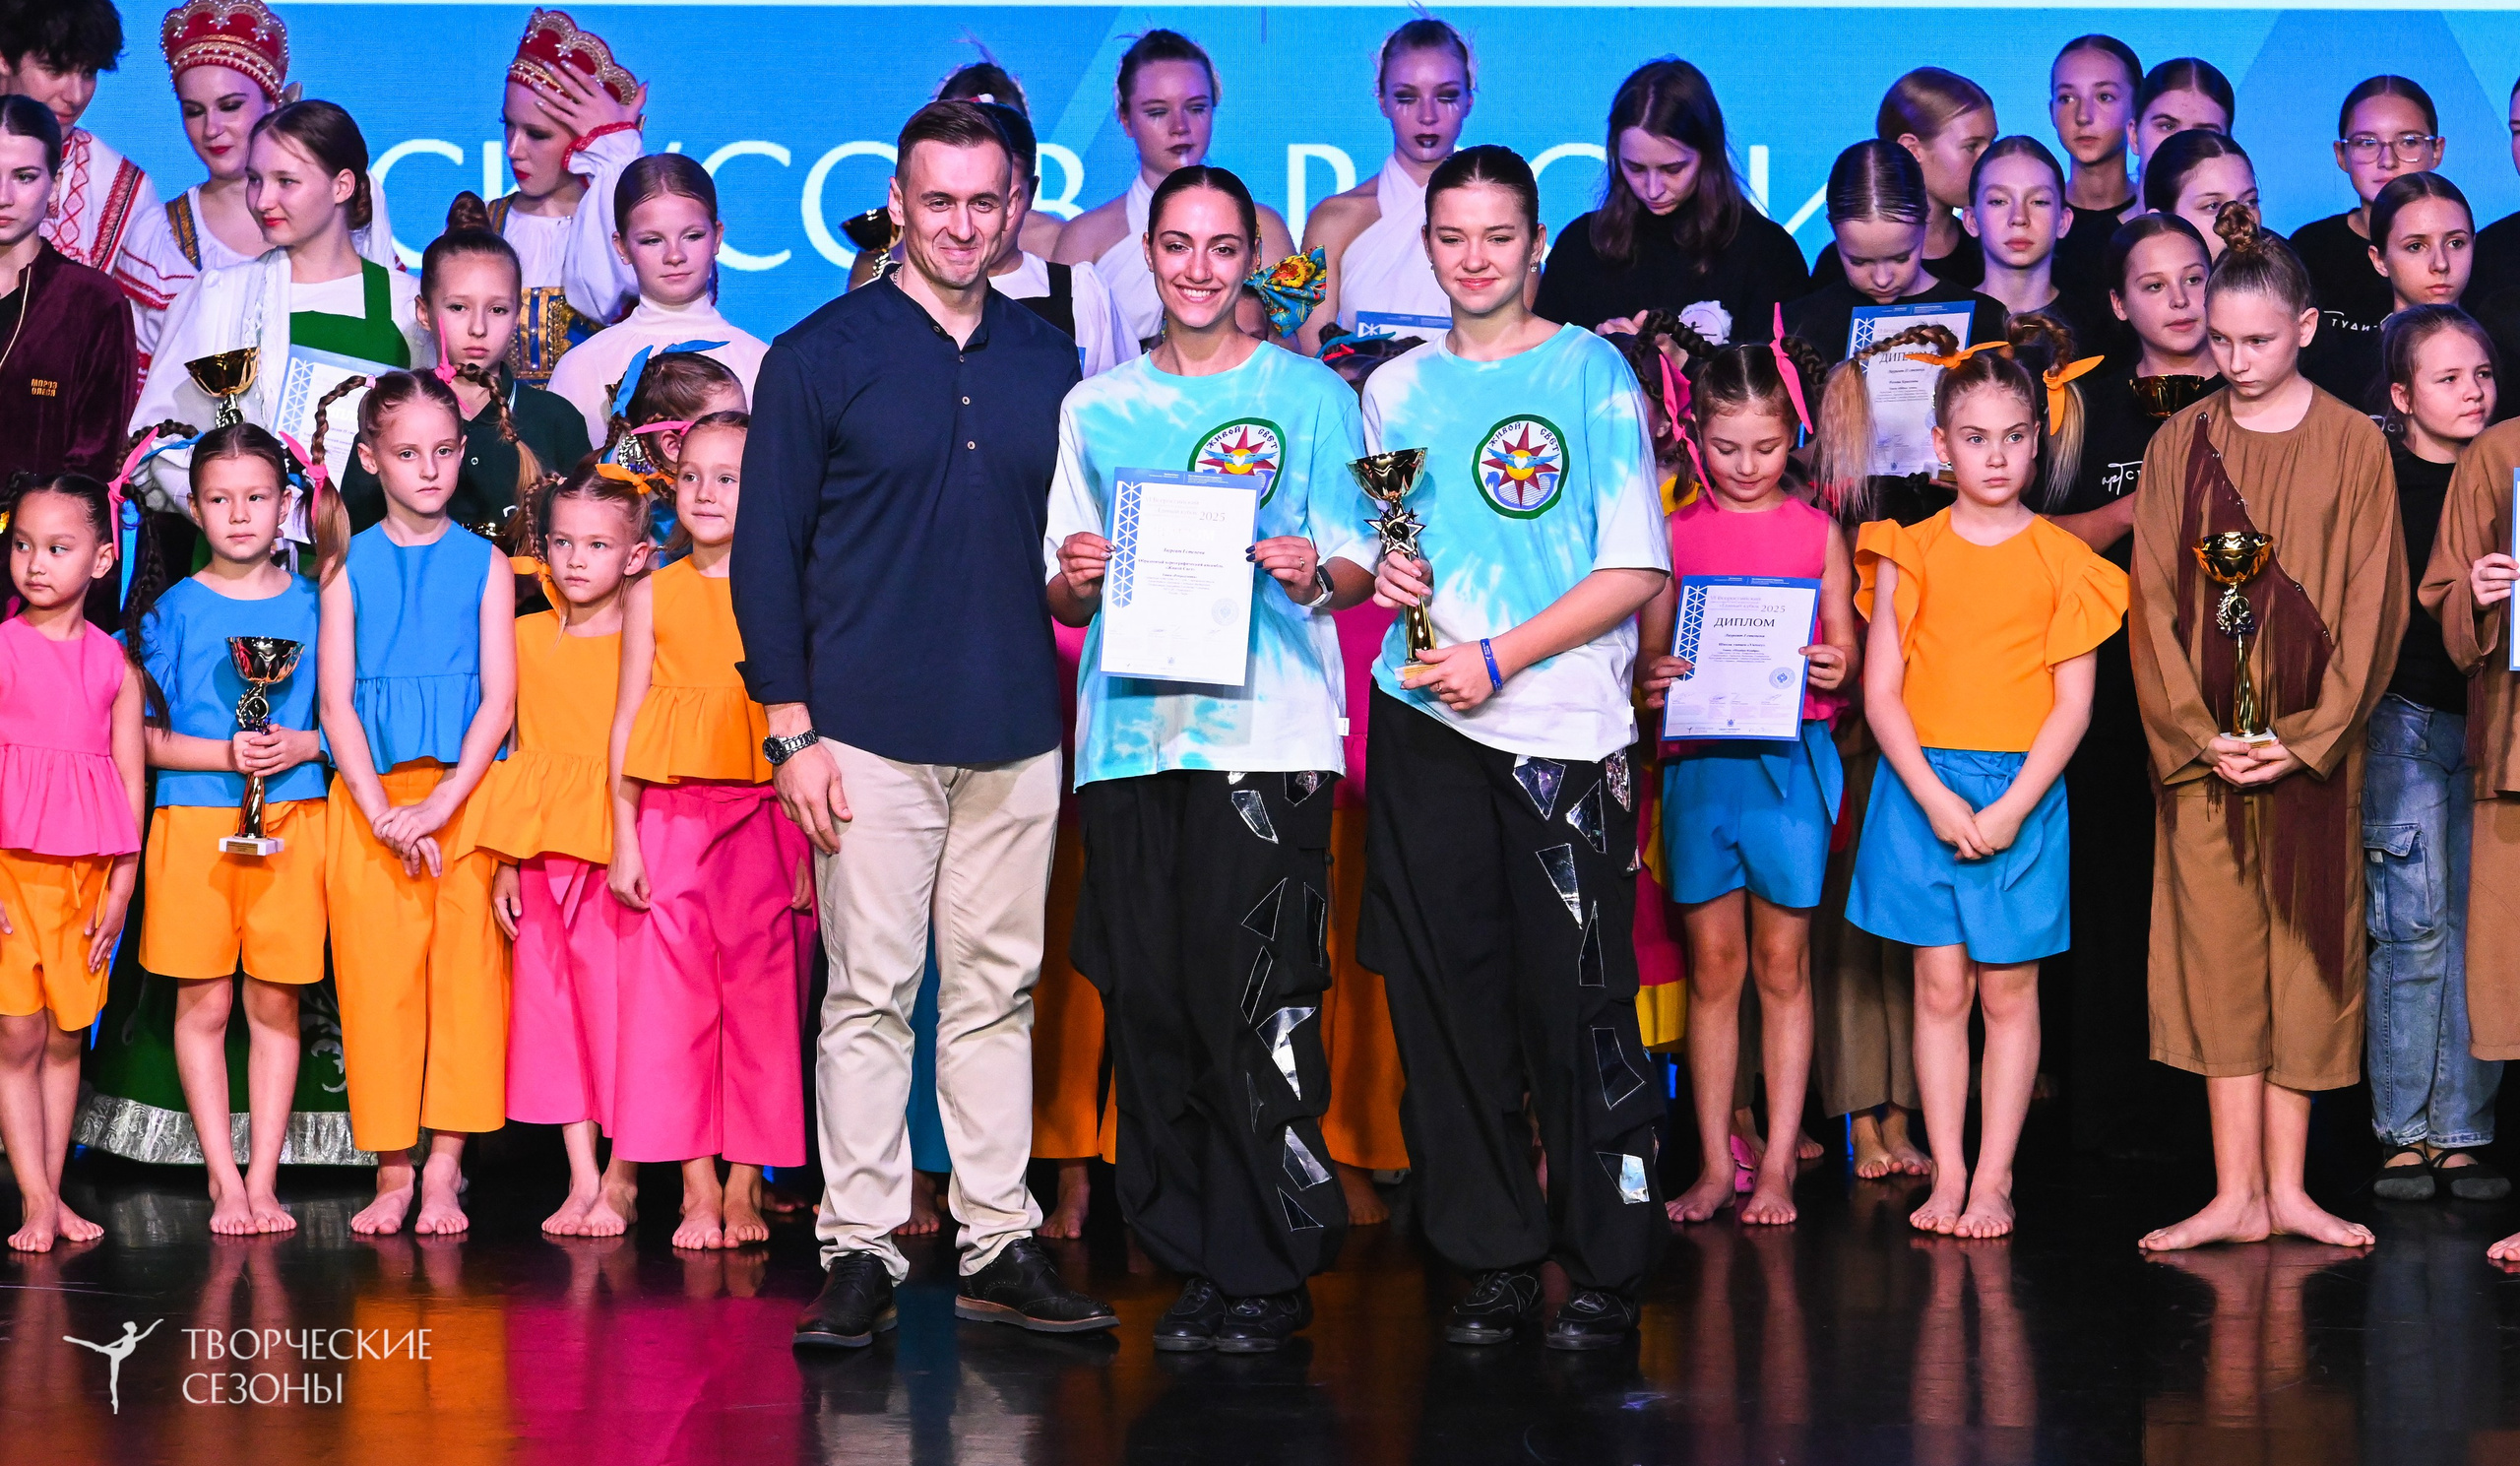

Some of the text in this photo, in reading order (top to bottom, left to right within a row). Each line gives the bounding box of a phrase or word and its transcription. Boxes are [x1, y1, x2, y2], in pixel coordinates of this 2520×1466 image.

[31, 378, 58, 389] МОРОЗ
[31, 387, 57, 397] ОЛЕСЯ
[1488, 421, 1560, 453] ЖИВОЙ СВЕТ
[1199, 511, 1226, 522] 2025
[1760, 605, 1786, 613] 2025
[1714, 617, 1775, 628] ДИПЛОМ
